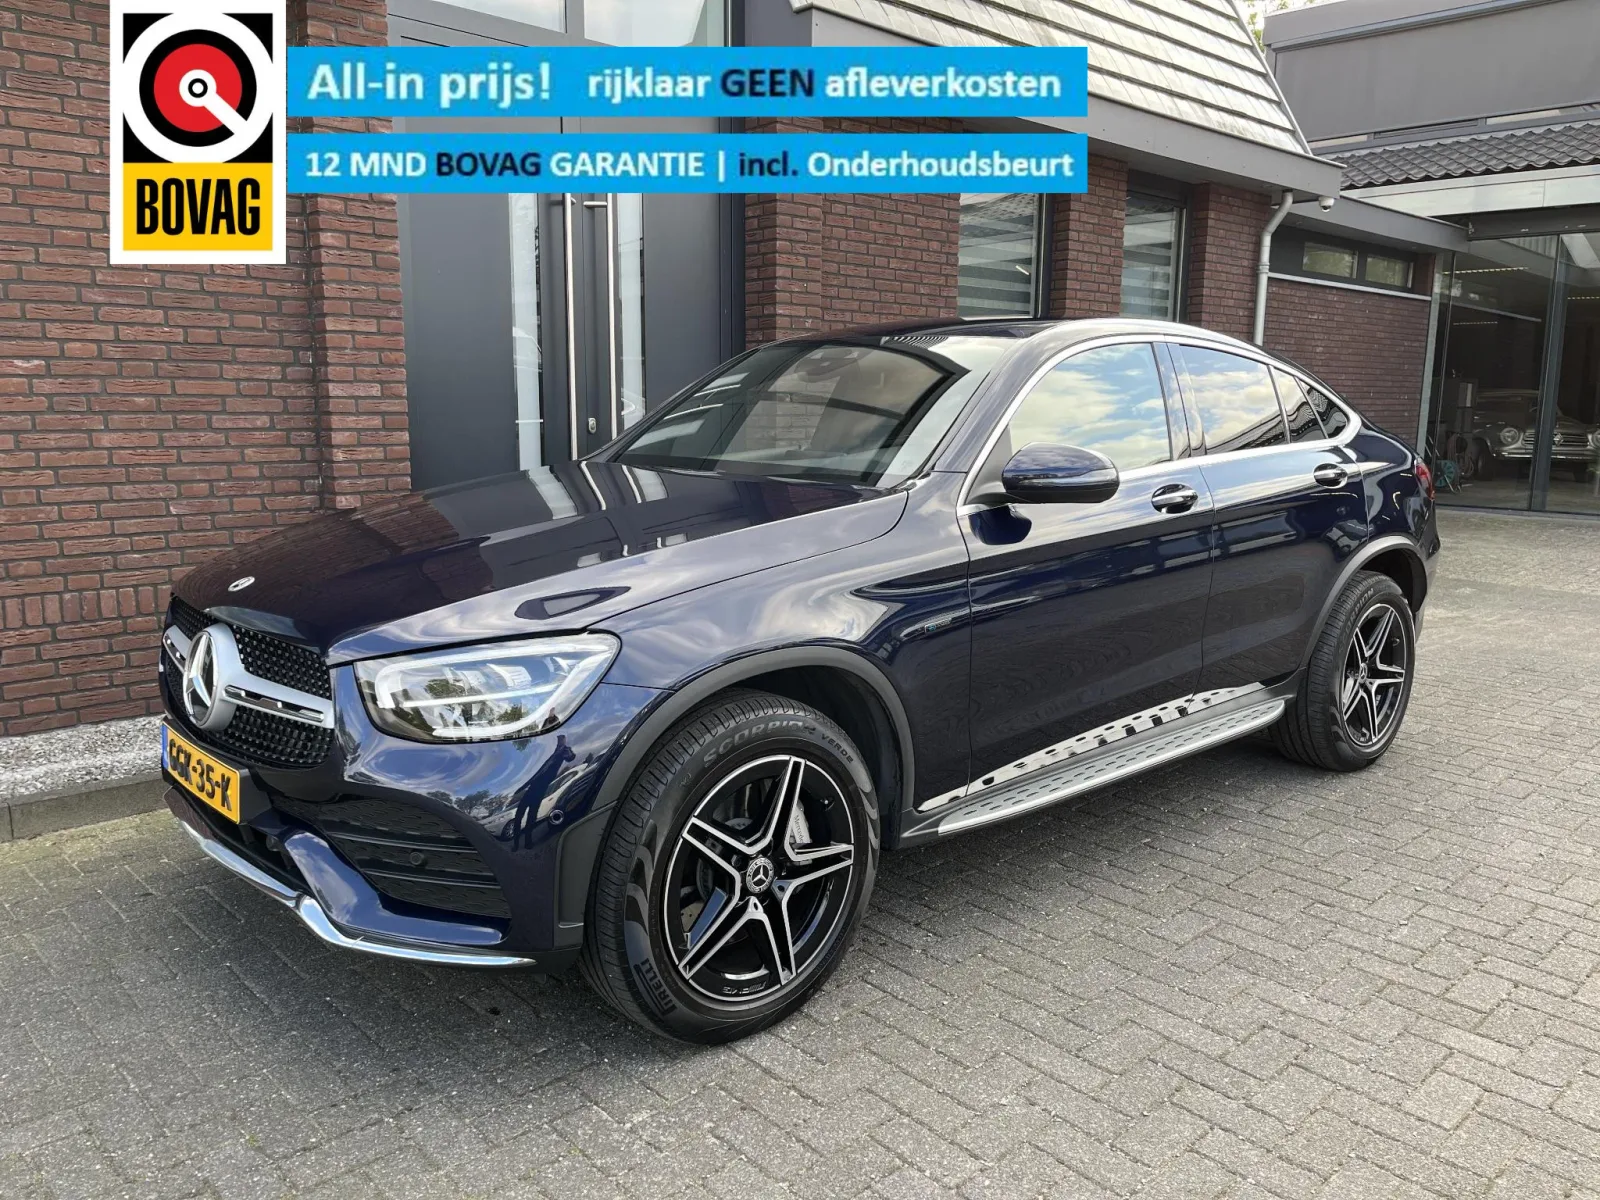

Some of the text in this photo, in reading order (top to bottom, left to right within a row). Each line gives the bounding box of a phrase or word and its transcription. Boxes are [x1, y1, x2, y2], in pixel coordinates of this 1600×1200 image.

[703, 720, 854, 768] SCORPION VERDE
[169, 738, 232, 812] GGK-35-K
[633, 957, 678, 1016] PIRELLI
